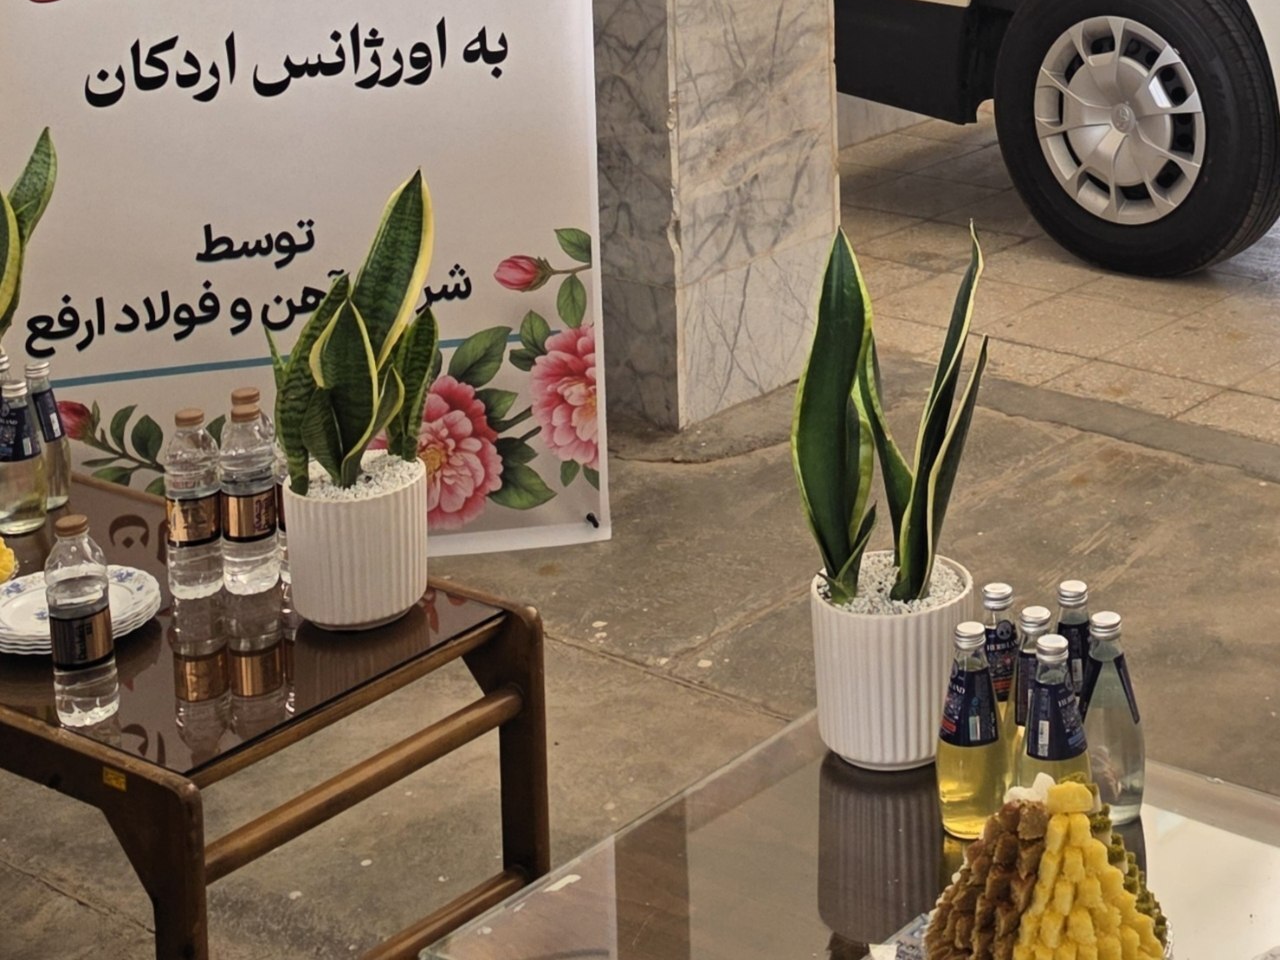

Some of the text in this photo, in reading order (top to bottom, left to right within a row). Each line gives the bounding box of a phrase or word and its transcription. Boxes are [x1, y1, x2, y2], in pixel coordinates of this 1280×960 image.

[84, 16, 509, 108] به اورژانس اردکان
[195, 217, 316, 268] توسط
[24, 263, 473, 356] شر هن و فولاد ارفع
